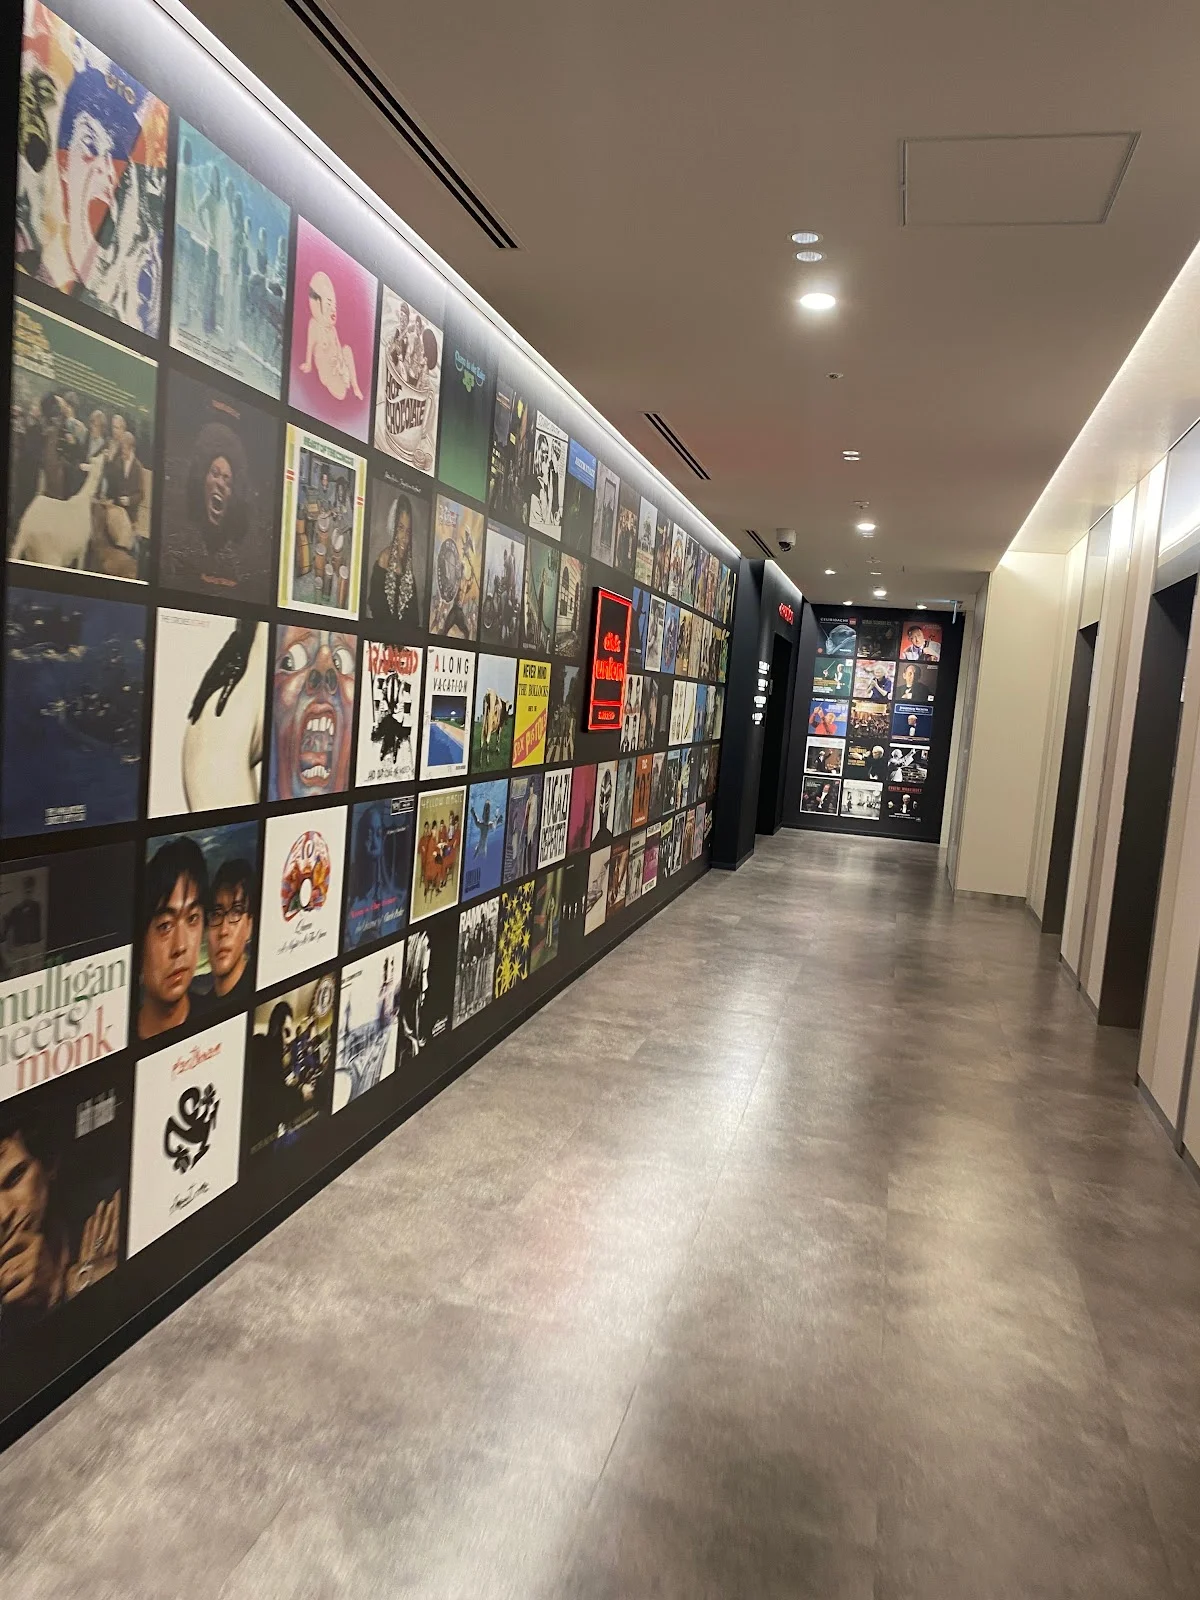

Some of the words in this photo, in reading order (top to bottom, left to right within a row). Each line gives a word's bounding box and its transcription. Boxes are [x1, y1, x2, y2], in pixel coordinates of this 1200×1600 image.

[523, 663, 537, 679] NEVER
[537, 665, 548, 680] MIND
[433, 677, 468, 693] VACATION
[518, 683, 528, 697] THE
[17, 1005, 114, 1090] monk
